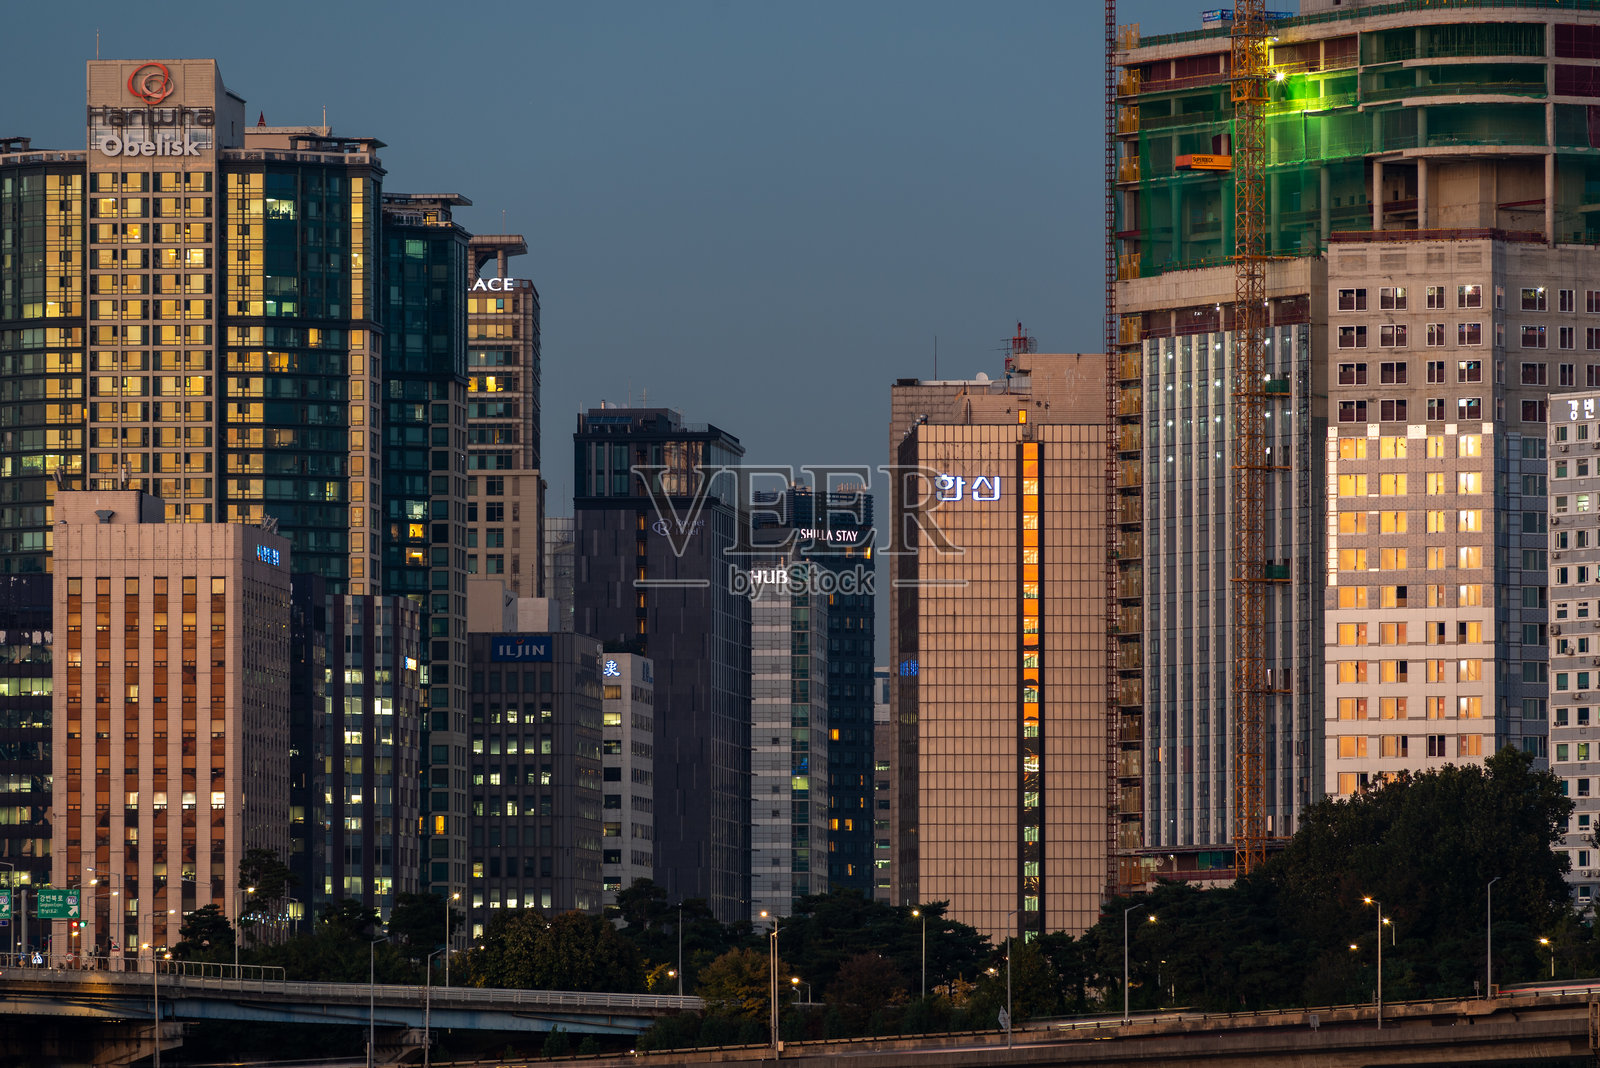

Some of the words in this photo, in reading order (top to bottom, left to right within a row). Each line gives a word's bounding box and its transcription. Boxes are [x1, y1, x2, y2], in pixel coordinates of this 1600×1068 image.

[87, 104, 215, 126] Hanwha
[100, 133, 200, 157] Obelisk
[468, 277, 514, 291] ACE
[1567, 398, 1595, 421] 강변
[934, 473, 1001, 501] 한신
[800, 528, 833, 541] SHILLA
[836, 530, 858, 542] STAY
[499, 644, 545, 658] ILJIN
